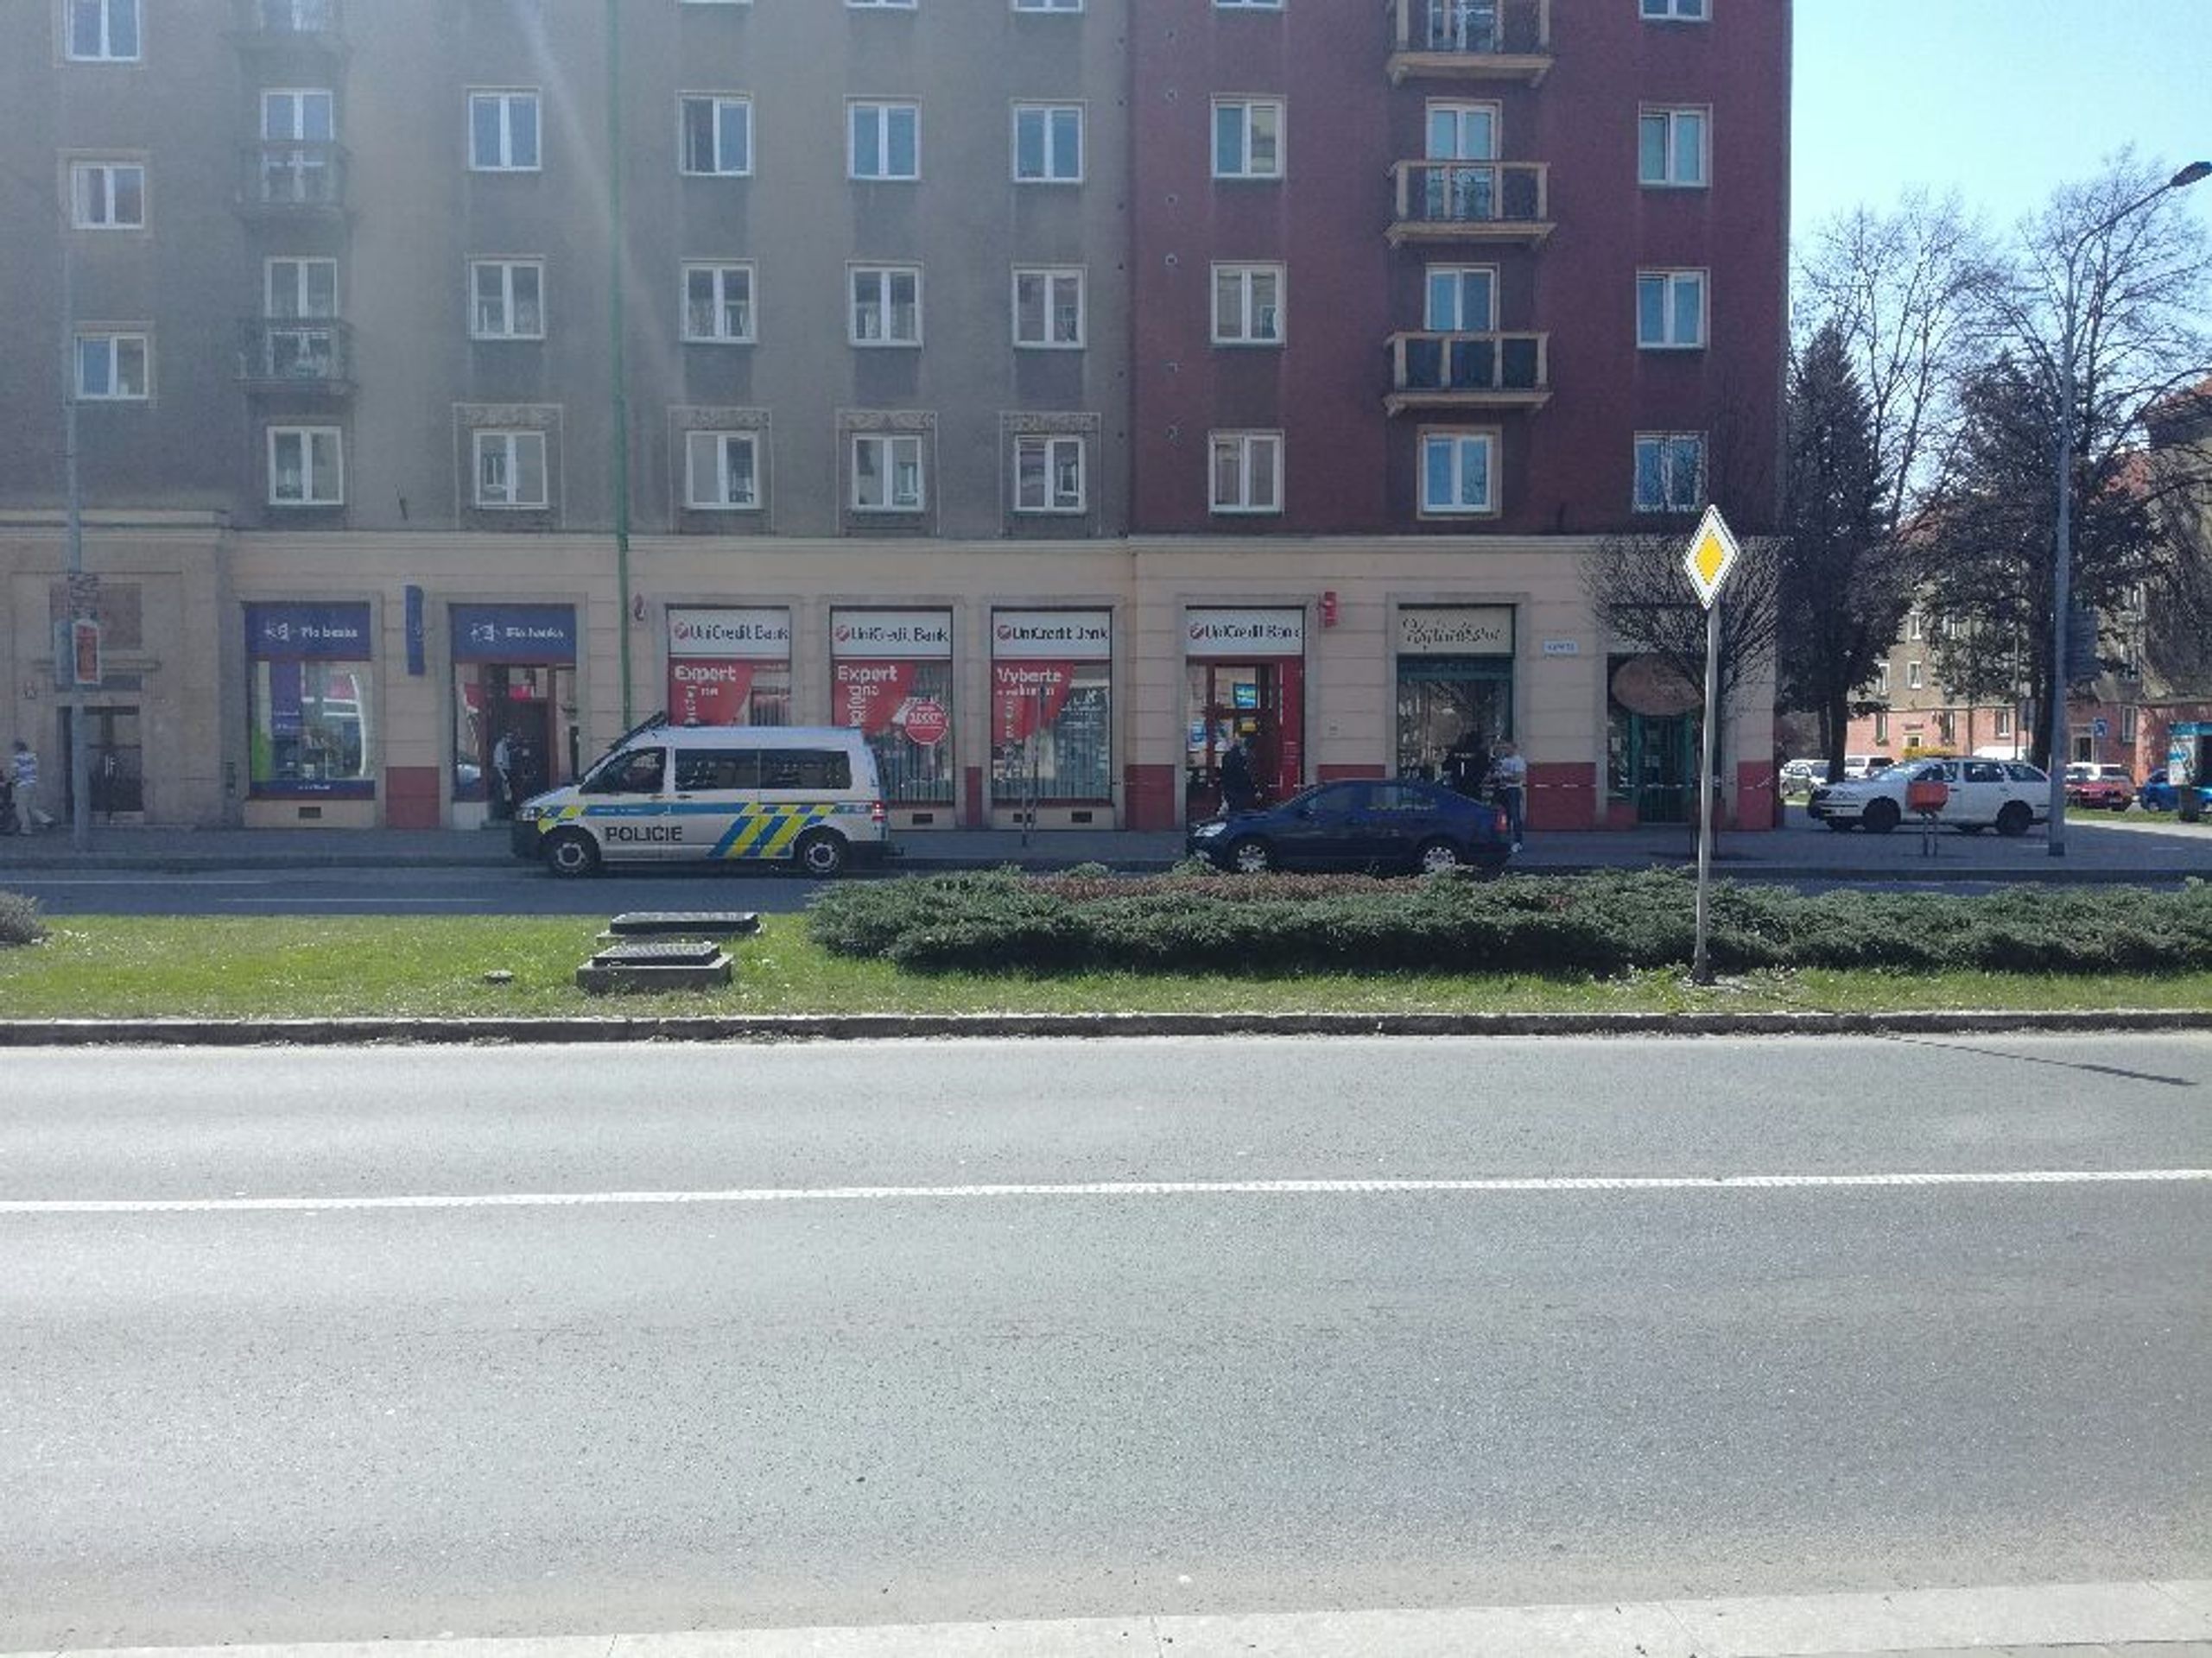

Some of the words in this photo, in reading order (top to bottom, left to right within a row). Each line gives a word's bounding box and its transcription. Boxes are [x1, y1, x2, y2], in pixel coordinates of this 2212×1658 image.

[914, 627, 948, 642] Bank
[674, 665, 737, 683] Expert
[837, 665, 898, 683] Expert
[997, 668, 1062, 685] Vyberte
[605, 826, 682, 841] POLICIE
